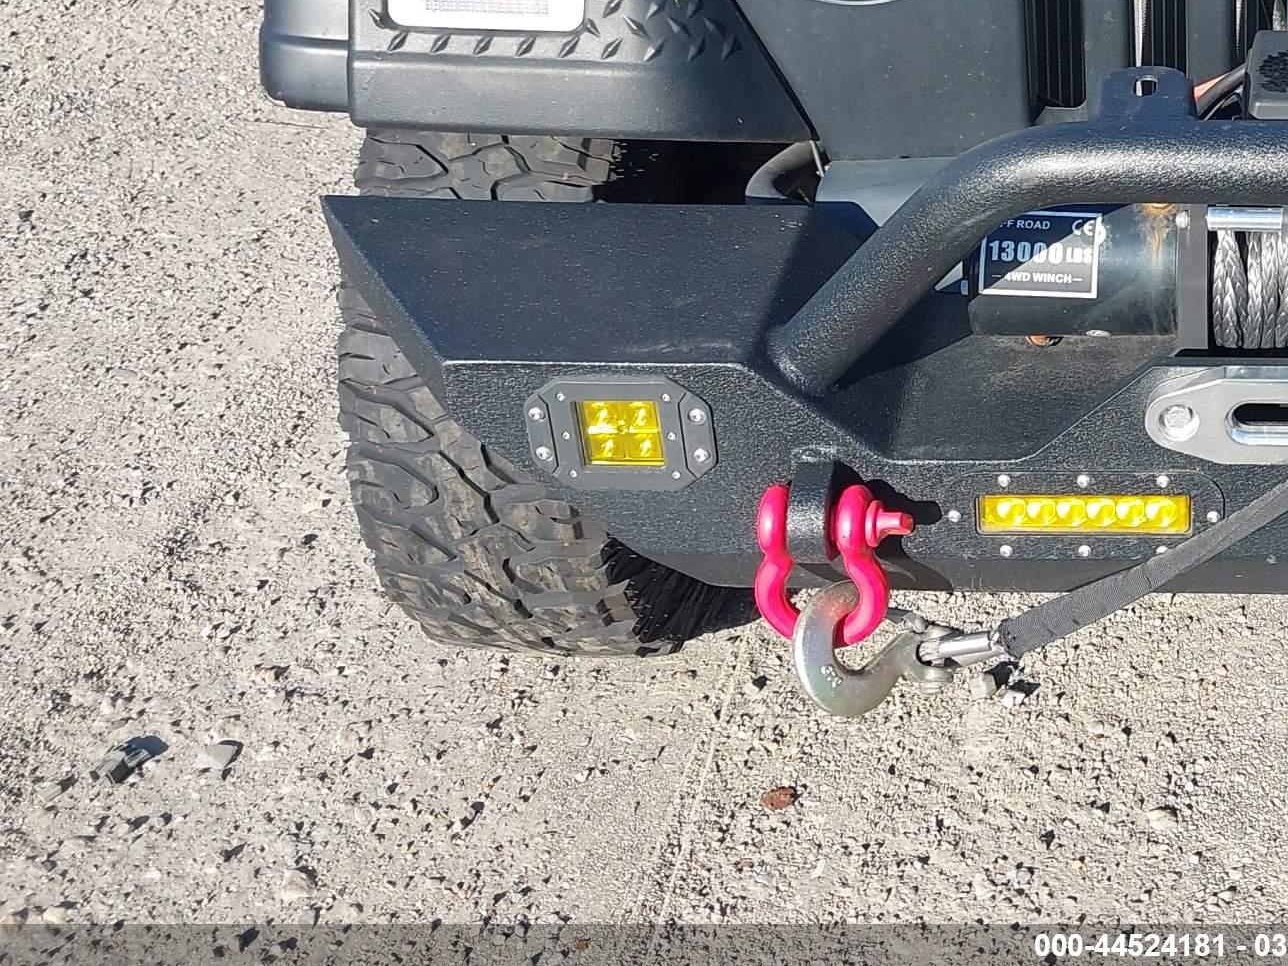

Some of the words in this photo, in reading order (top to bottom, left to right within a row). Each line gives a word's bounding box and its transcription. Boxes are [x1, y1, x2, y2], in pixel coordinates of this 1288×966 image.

[1016, 220, 1051, 230] ROAD
[988, 240, 1064, 264] 13000
[1066, 246, 1093, 264] LBS
[1004, 272, 1031, 282] 4WD
[1032, 273, 1072, 283] WINCH
